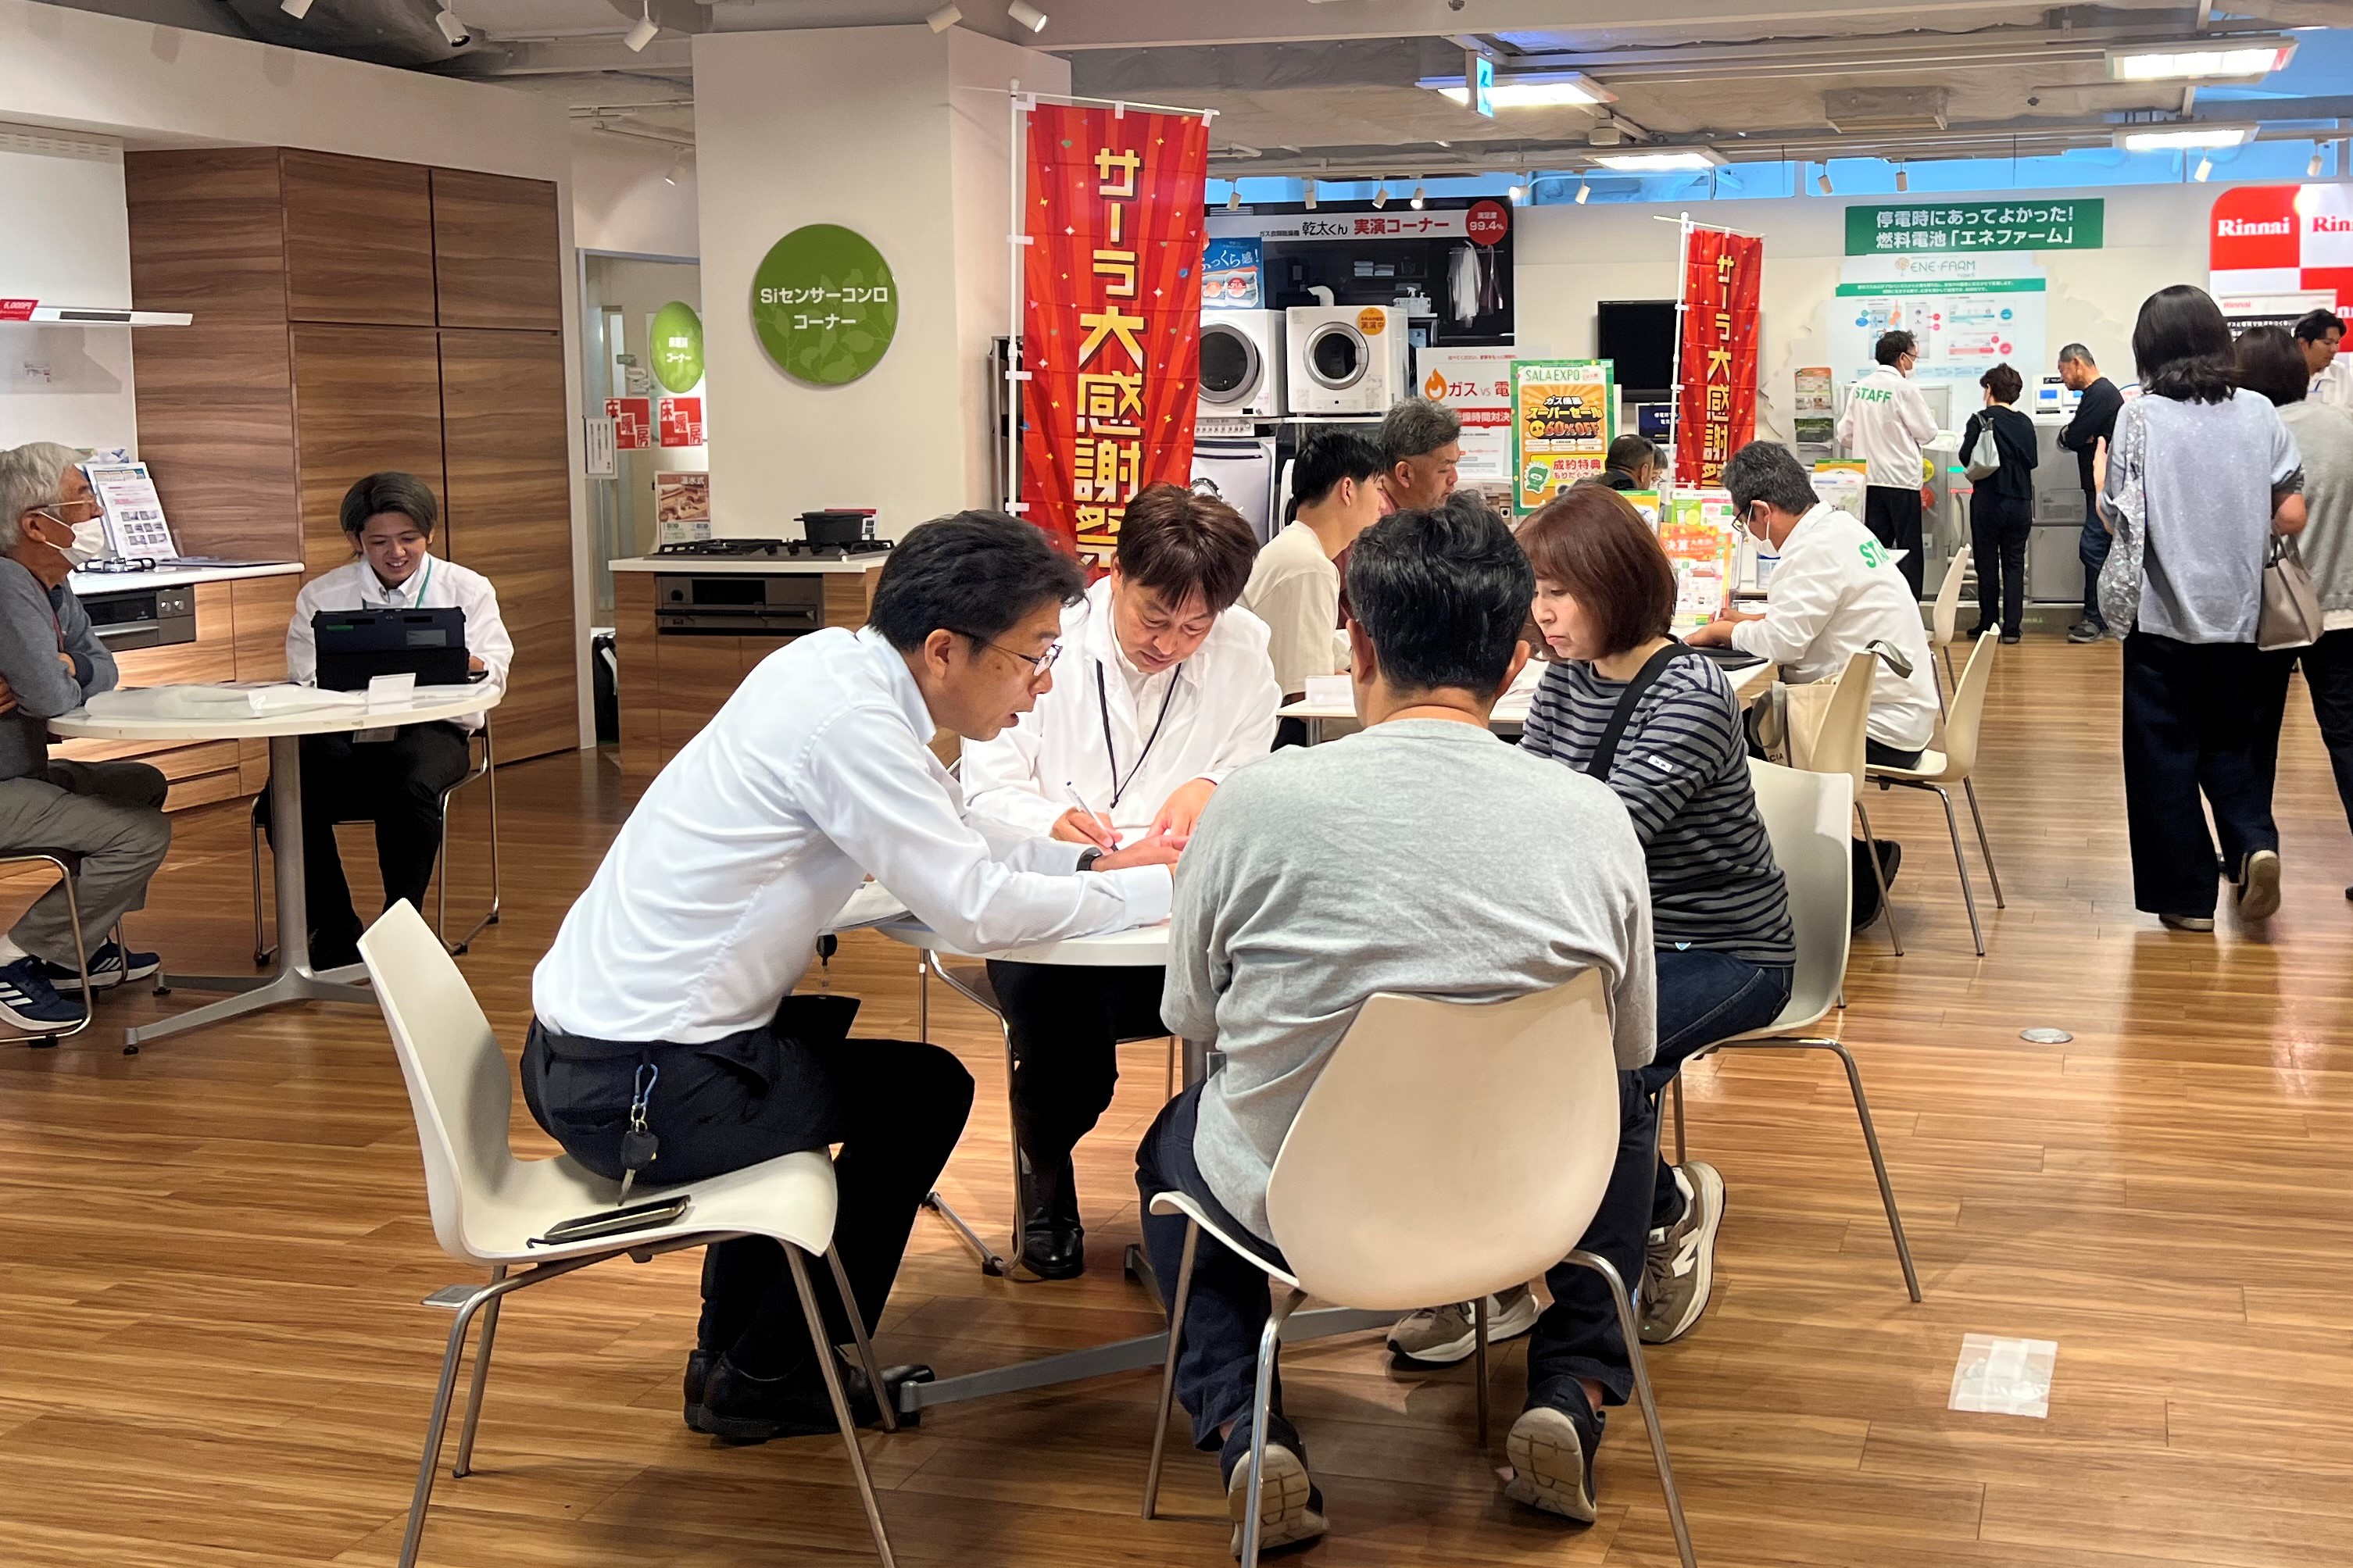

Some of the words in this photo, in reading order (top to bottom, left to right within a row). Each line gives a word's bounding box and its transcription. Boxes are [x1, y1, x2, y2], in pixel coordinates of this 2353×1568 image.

[1354, 218, 1449, 235] 実演コーナー
[1470, 221, 1504, 231] 99.4%
[2217, 217, 2290, 237] Rinnai
[2312, 216, 2353, 232] Rin
[1876, 227, 2073, 249] 燃料電池「エネファーム」
[760, 287, 889, 304] Siセンサーコンロ
[794, 313, 856, 330] コーナー
[667, 352, 692, 363] コーナー
[1525, 370, 1551, 381] SALA
[1554, 370, 1580, 381] EXPO
[1449, 381, 1478, 396] ガス
[1855, 387, 1892, 403] STAFF
[1525, 406, 1604, 420] スーパーセール
